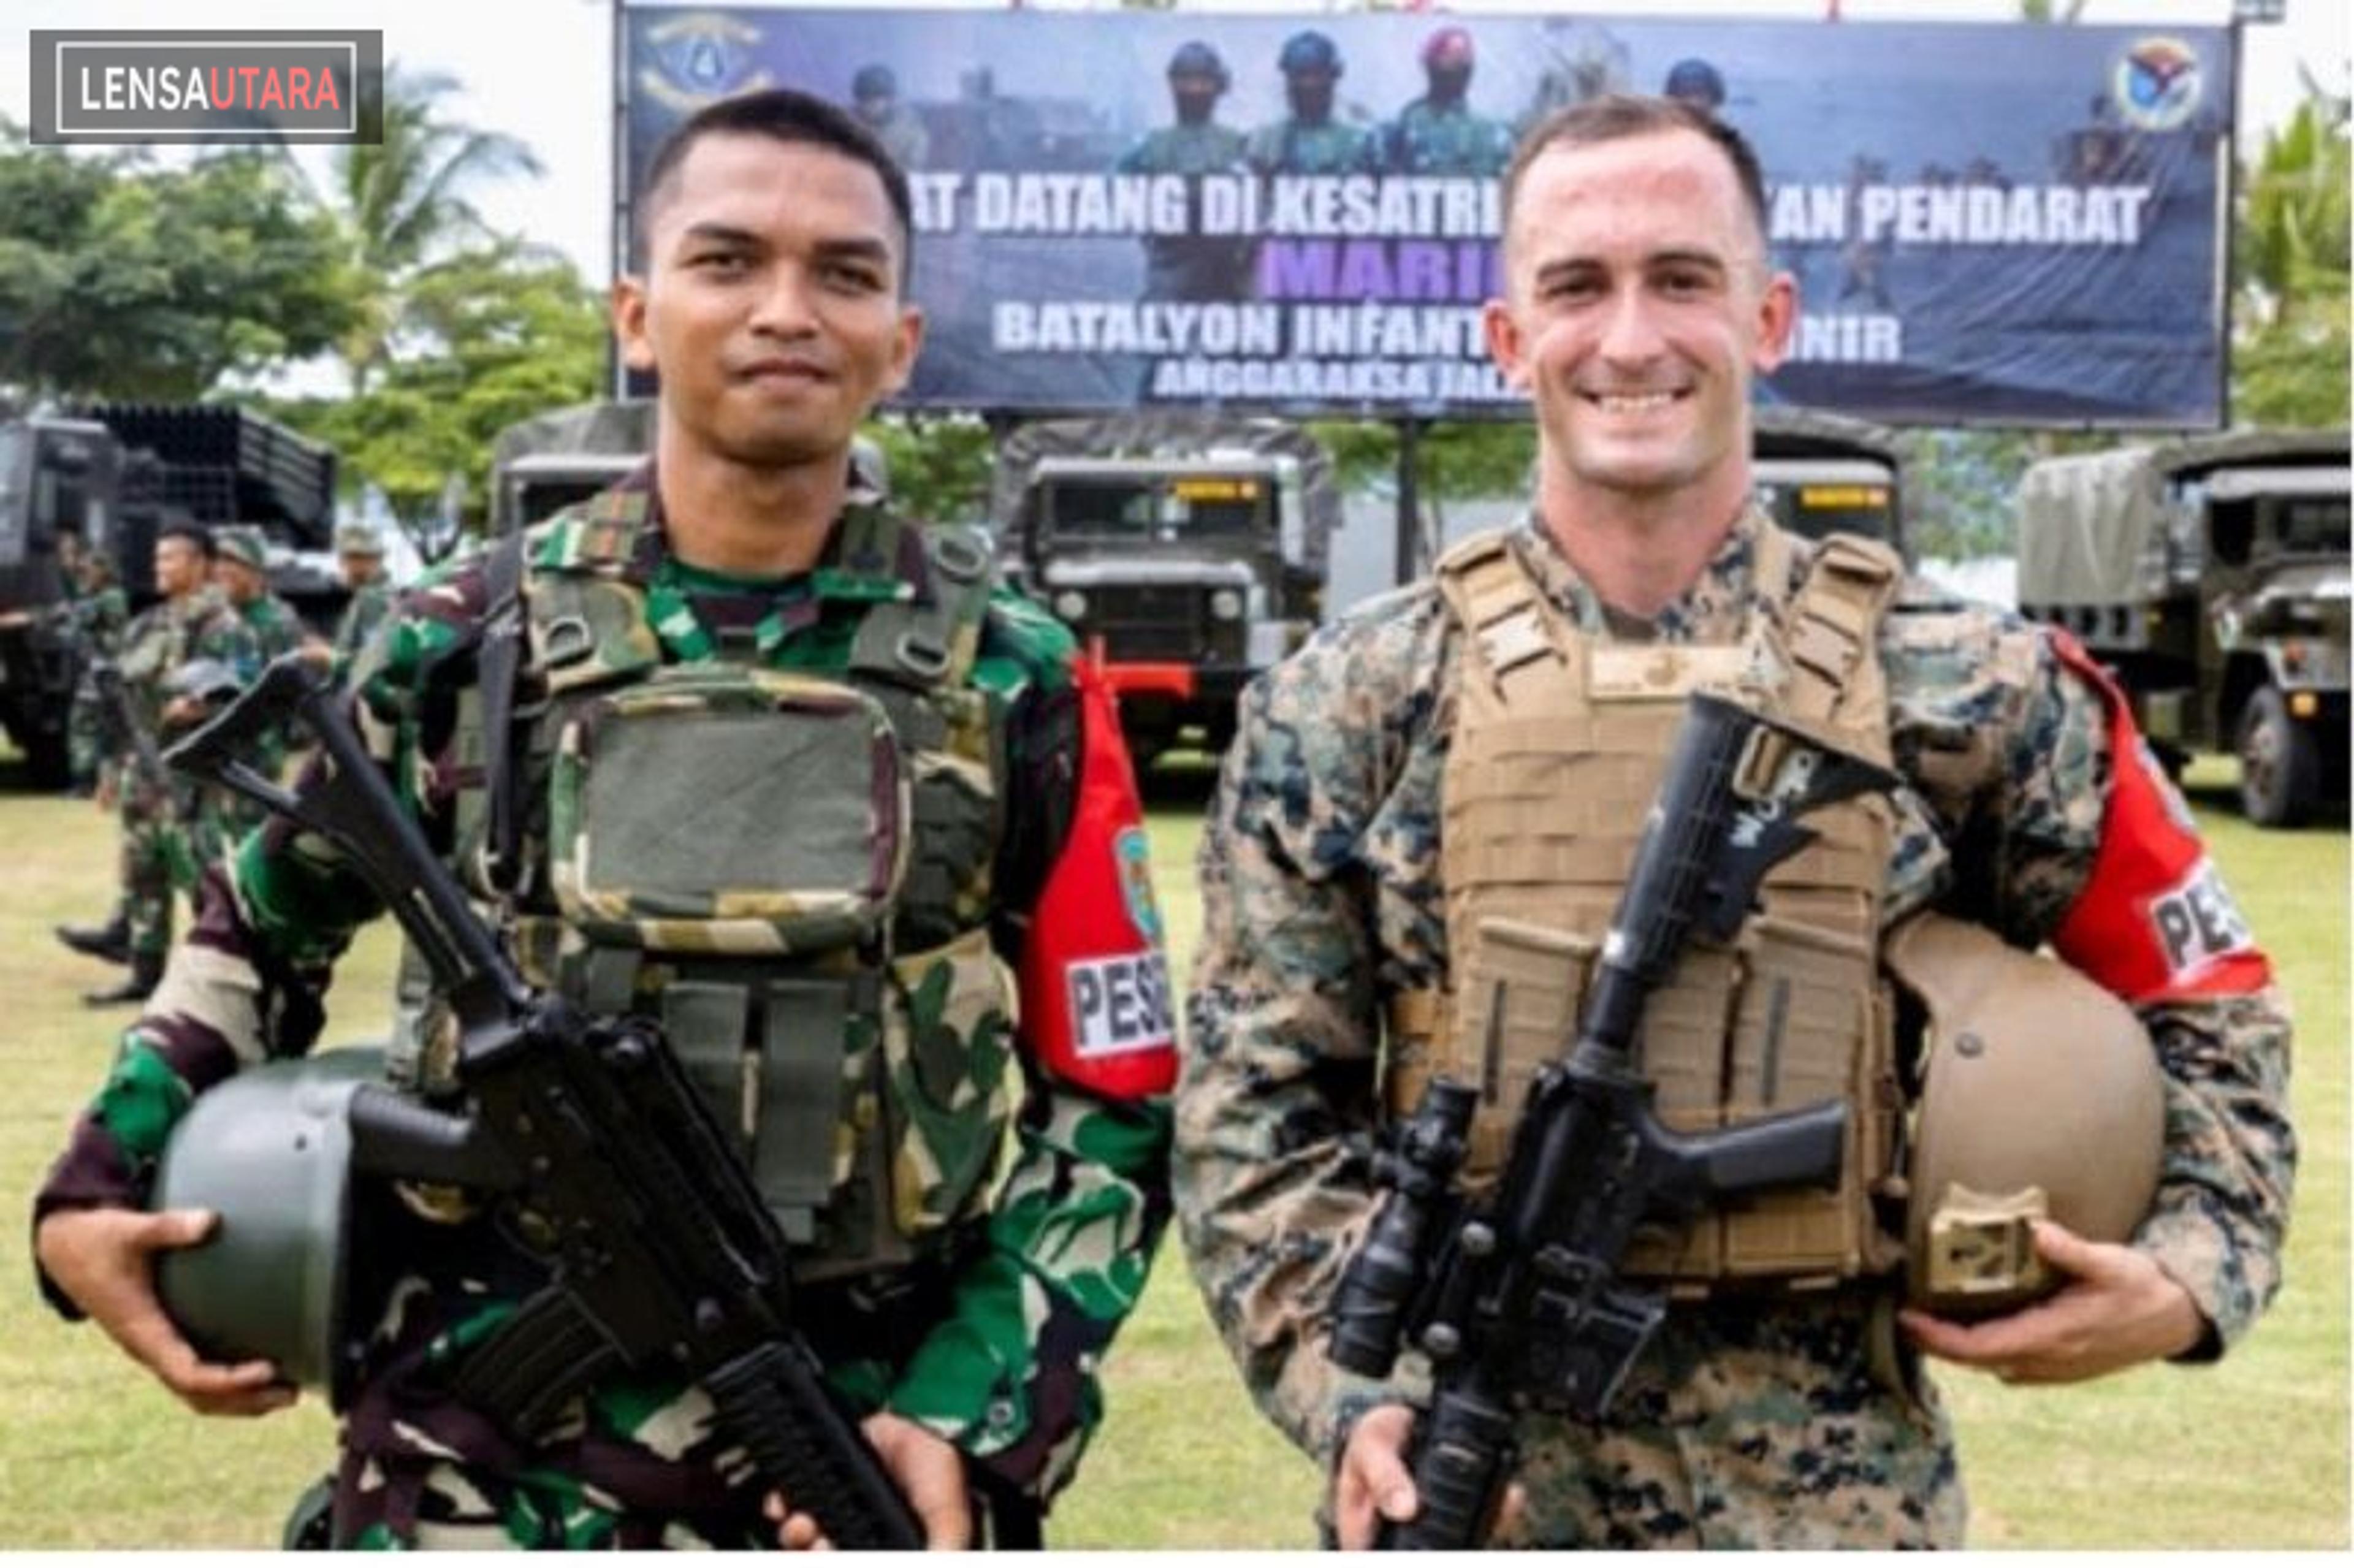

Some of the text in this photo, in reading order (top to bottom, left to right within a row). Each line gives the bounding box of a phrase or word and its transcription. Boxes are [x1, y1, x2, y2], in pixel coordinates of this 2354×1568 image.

[976, 173, 1187, 234] DATANG
[1271, 174, 1502, 237] KESATRI
[1766, 185, 1844, 241] AN
[1862, 185, 2150, 244] PENDARAT
[1259, 239, 1507, 299] MARI
[992, 303, 1278, 355] BATALYON
